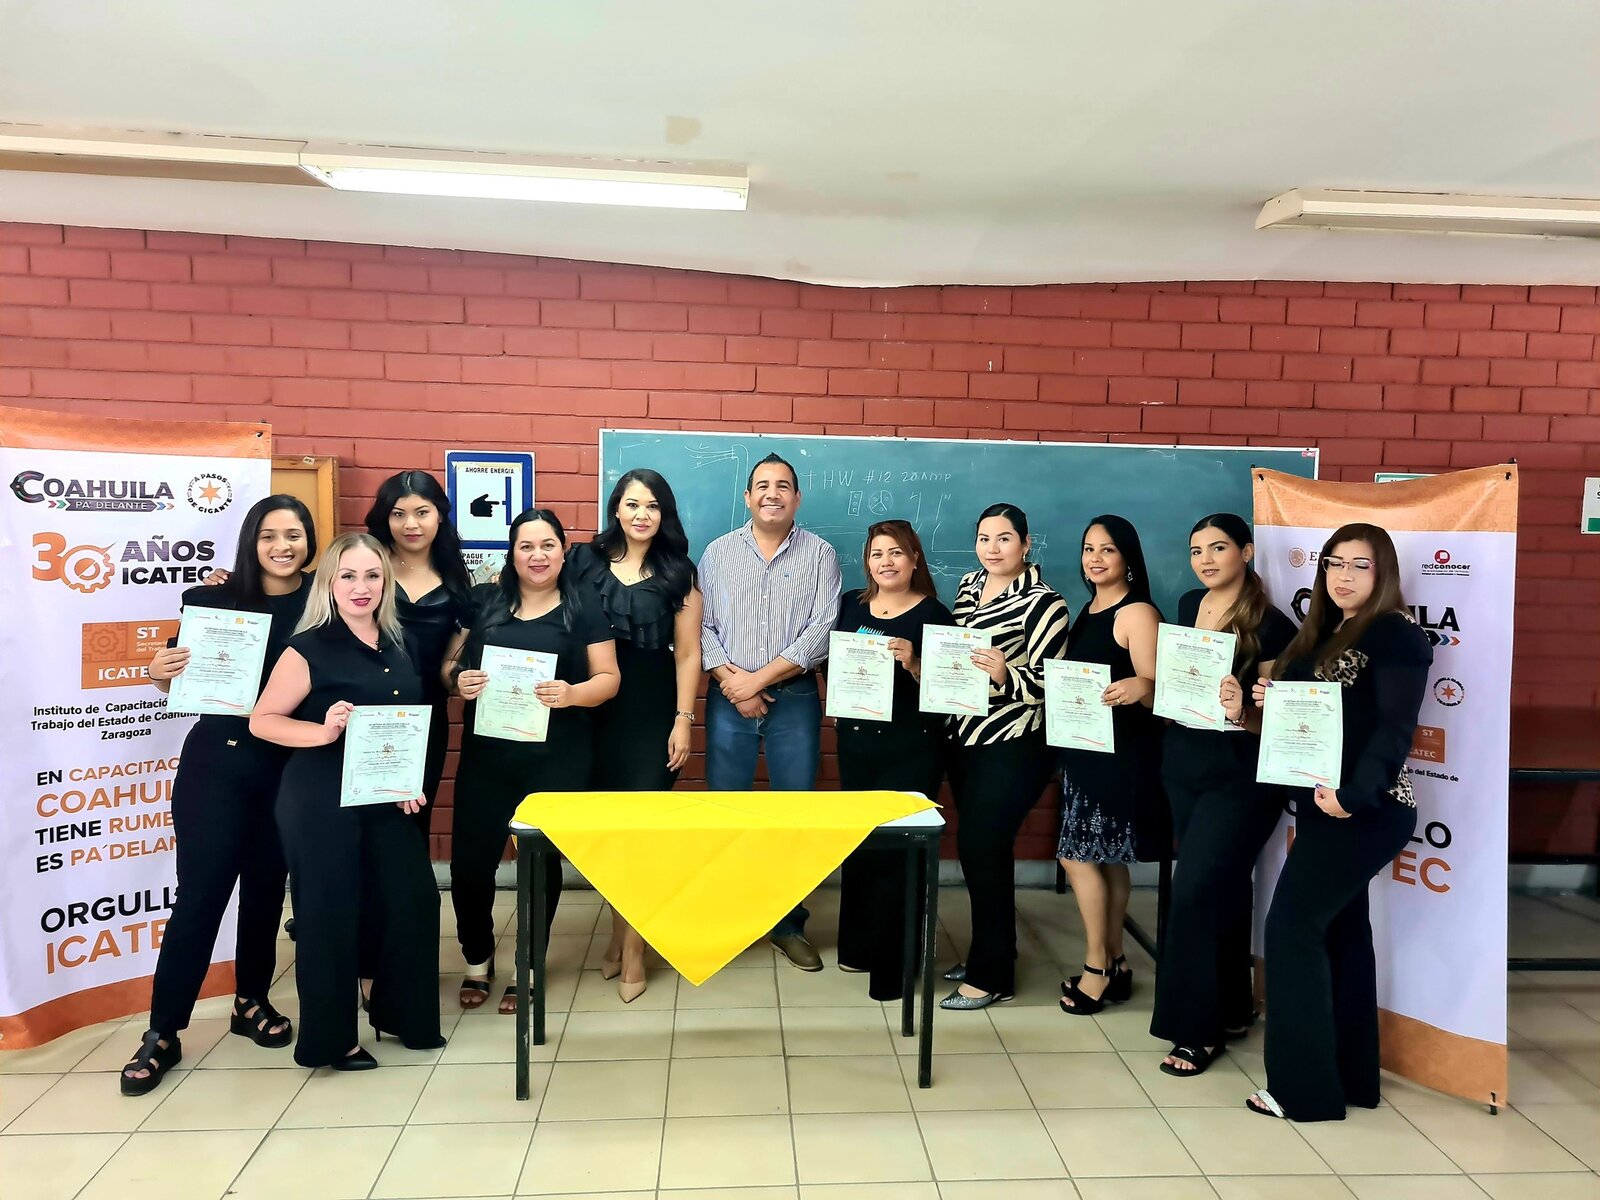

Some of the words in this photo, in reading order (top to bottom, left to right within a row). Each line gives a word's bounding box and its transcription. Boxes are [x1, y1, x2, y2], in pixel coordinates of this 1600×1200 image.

[8, 470, 175, 503] COAHUILA
[200, 473, 228, 483] PASOS
[96, 501, 147, 510] DELANTE
[120, 535, 215, 563] AÑOS
[136, 626, 160, 639] ST
[98, 666, 149, 681] ICATE
[33, 706, 82, 716] Instituto
[85, 705, 99, 714] de
[105, 697, 168, 713] Capacitació
[31, 719, 74, 731] Trabajo
[77, 718, 95, 728] del
[98, 715, 135, 727] Estado
[138, 713, 152, 723] de
[101, 728, 152, 741] Zaragoza
[1422, 729, 1434, 737] ST
[37, 769, 63, 786] EN
[69, 757, 180, 782] CAPACITAC
[1415, 768, 1425, 776] del
[1426, 770, 1449, 780] Estado
[36, 779, 172, 818] COAHUI
[34, 820, 102, 846] TIENE
[36, 852, 64, 874] ES
[40, 886, 176, 933] ORGULL
[46, 918, 169, 975] ICATE
